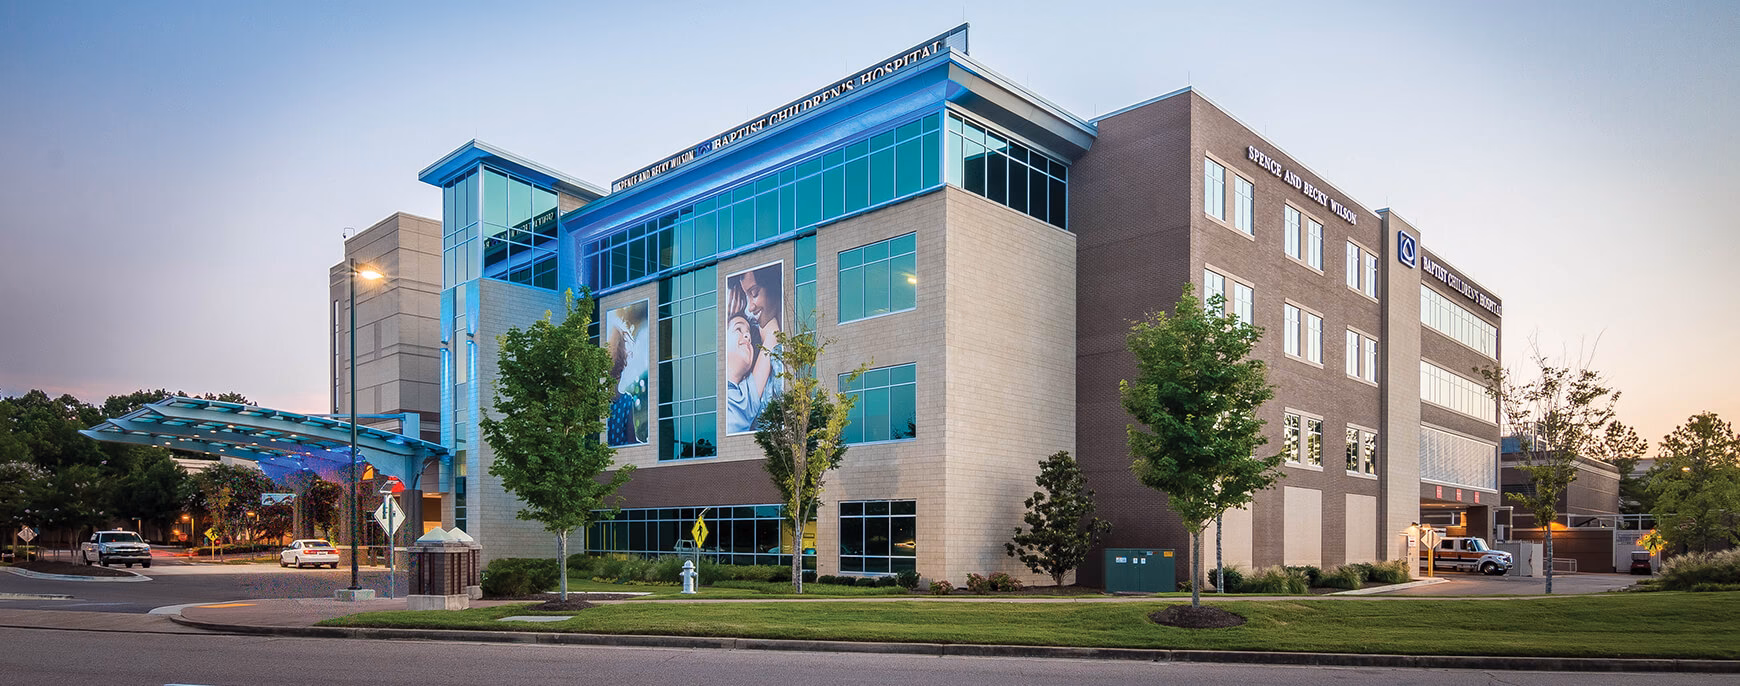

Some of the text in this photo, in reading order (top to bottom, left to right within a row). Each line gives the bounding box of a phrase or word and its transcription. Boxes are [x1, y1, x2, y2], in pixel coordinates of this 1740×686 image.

[639, 169, 651, 183] AND
[652, 160, 671, 178] BECKY
[670, 149, 695, 169] WILSON
[709, 119, 766, 151] BAPTIST
[860, 41, 940, 86] HOSPITAL
[1248, 145, 1357, 226] SPENCE AND BECKY WILSON
[1422, 255, 1449, 284] BAPTIST
[1447, 272, 1479, 304] CHILDREN'S
